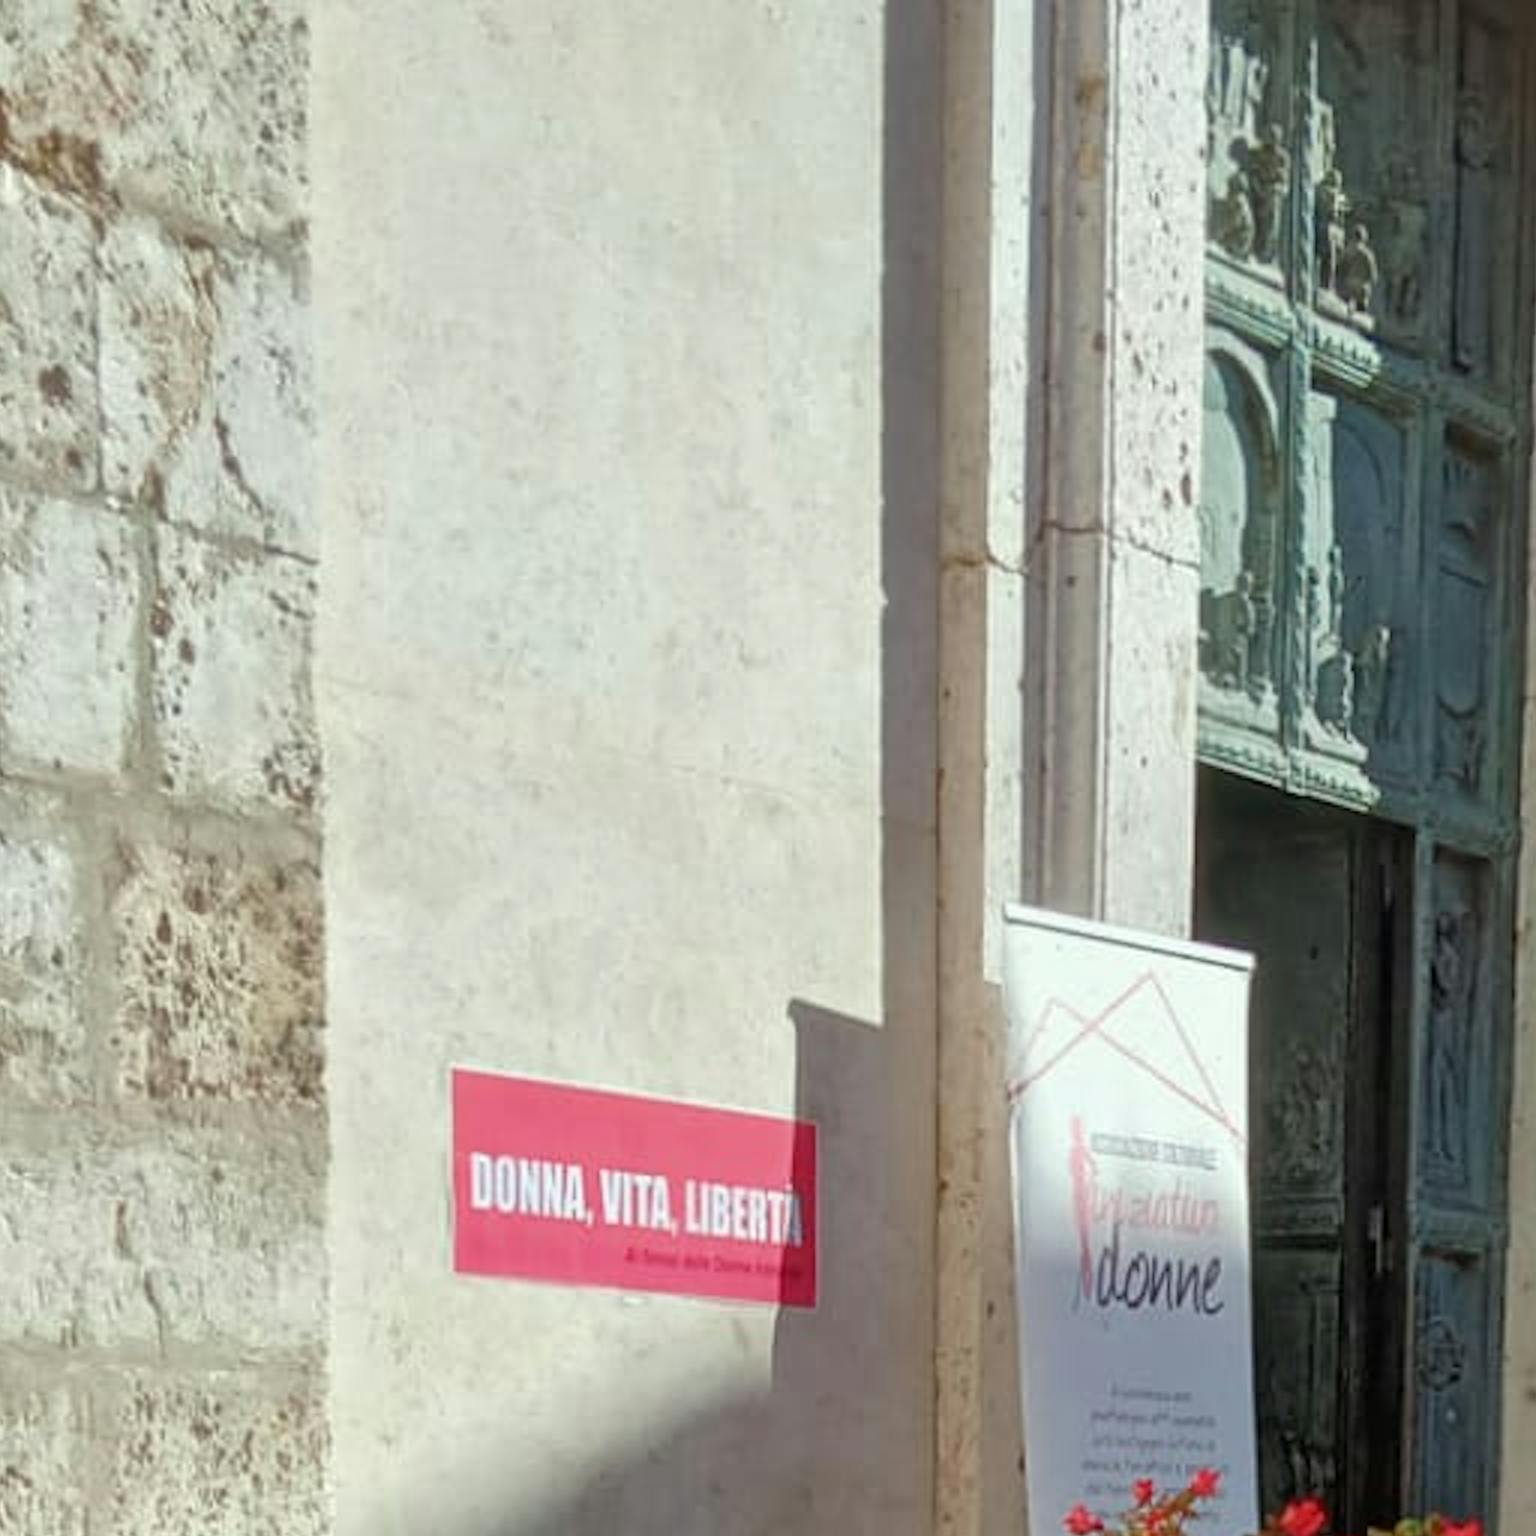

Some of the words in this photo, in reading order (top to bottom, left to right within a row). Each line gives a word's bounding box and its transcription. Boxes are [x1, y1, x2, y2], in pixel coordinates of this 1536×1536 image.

[469, 1151, 595, 1227] DONNA,
[599, 1168, 679, 1239] VITA,
[1096, 1222, 1225, 1316] donne
